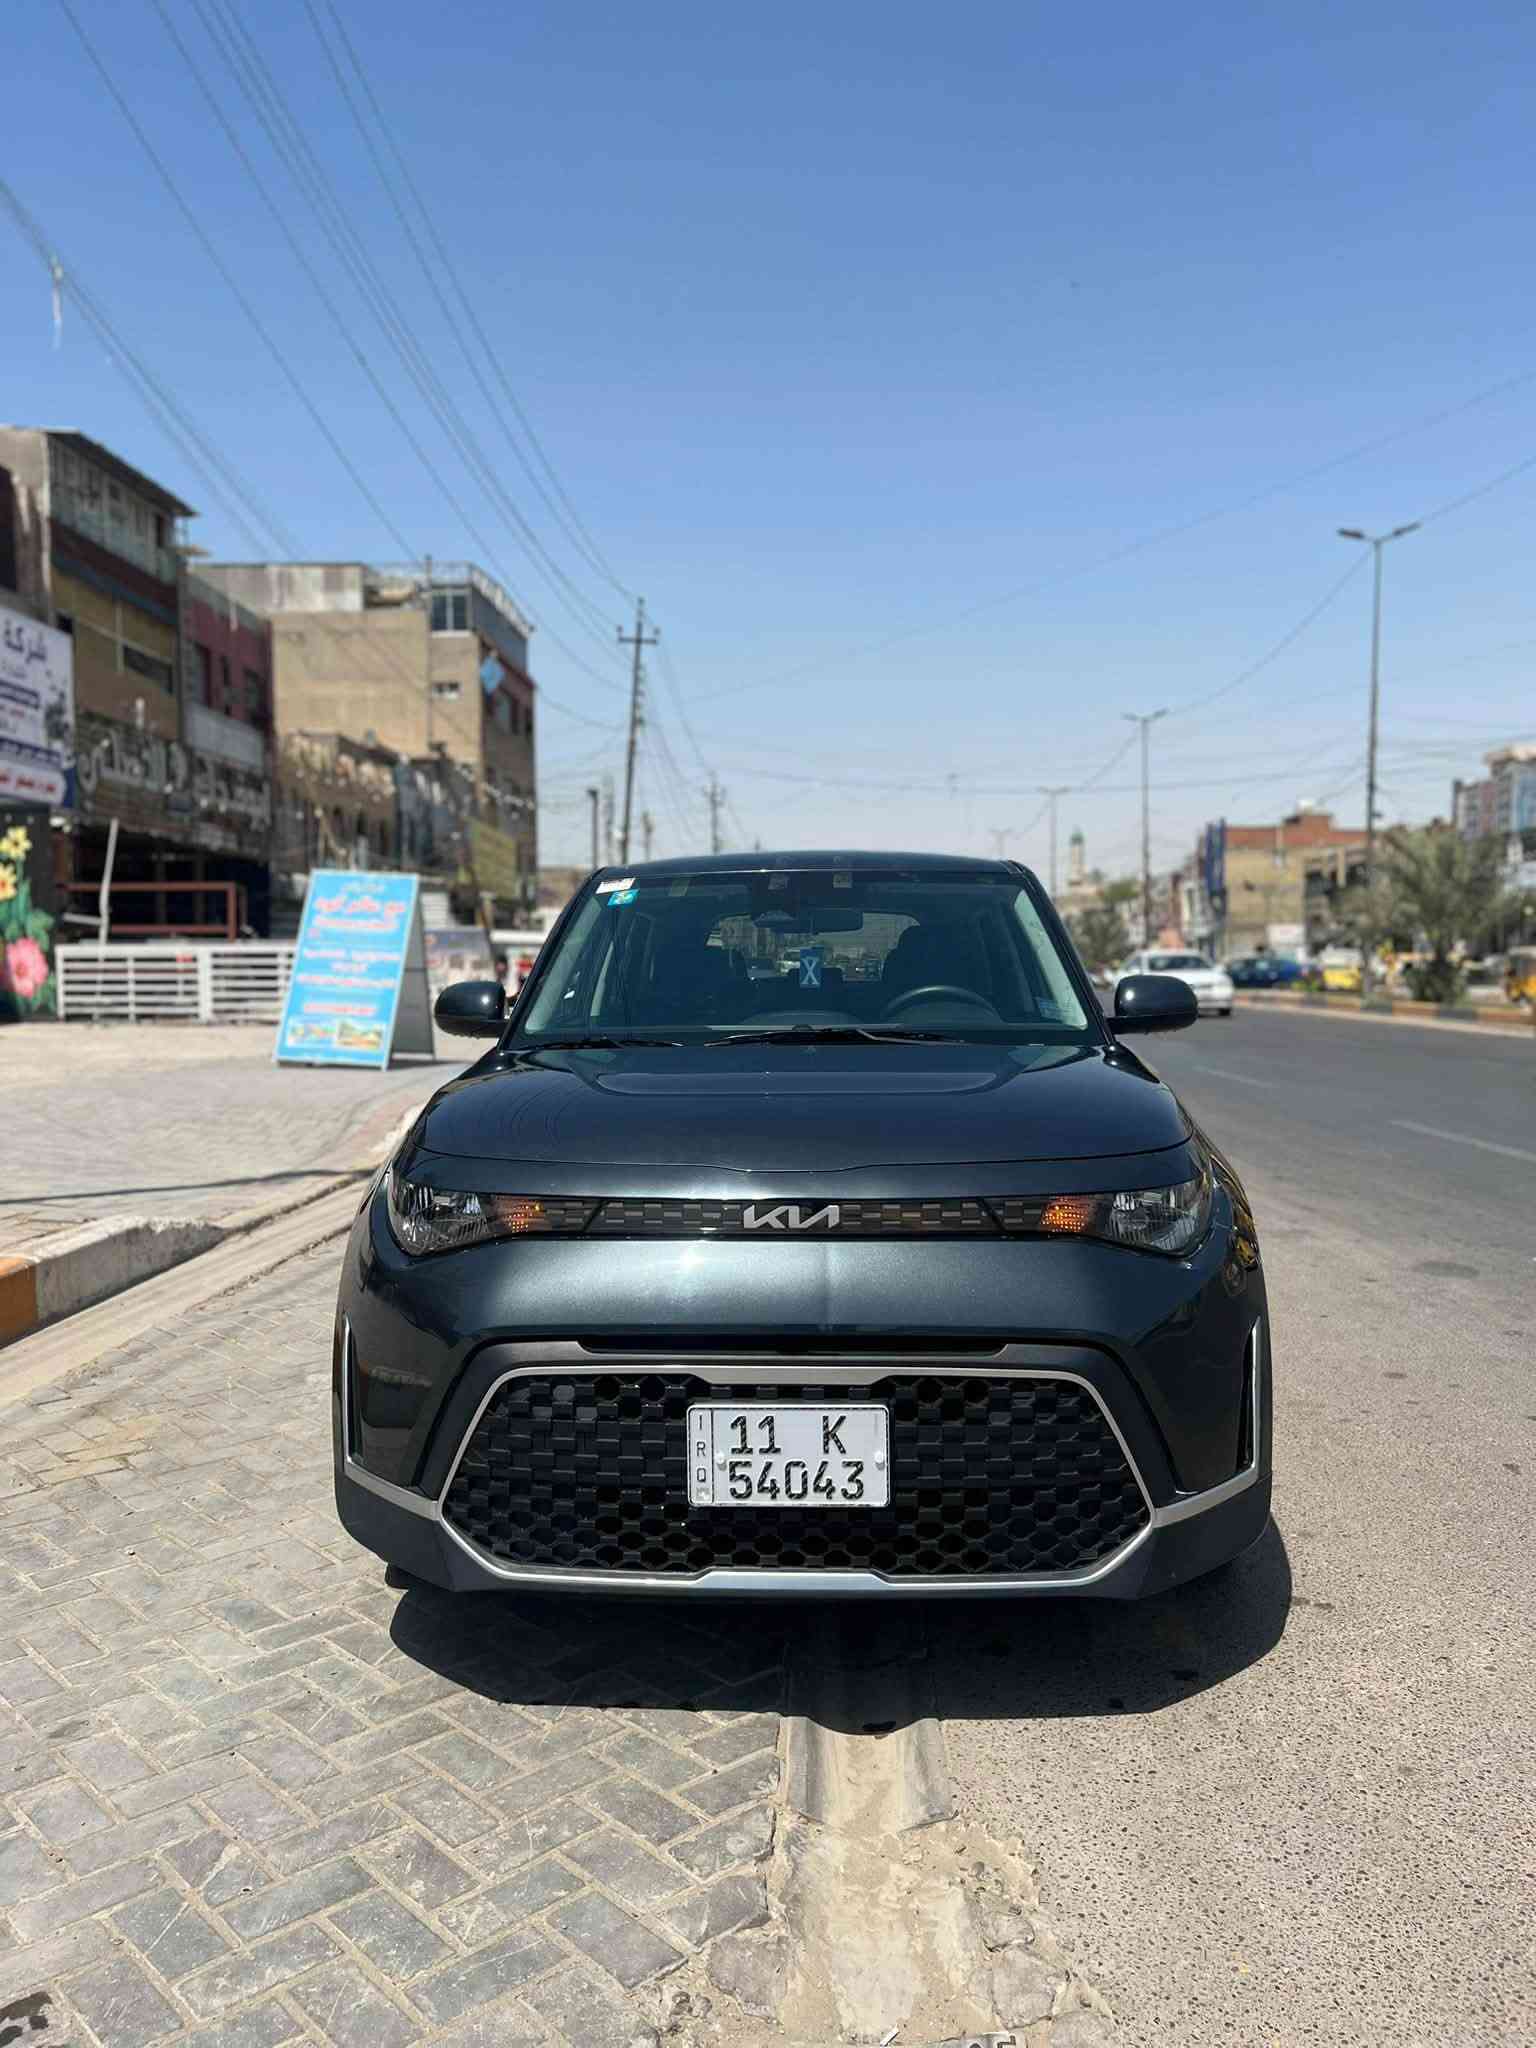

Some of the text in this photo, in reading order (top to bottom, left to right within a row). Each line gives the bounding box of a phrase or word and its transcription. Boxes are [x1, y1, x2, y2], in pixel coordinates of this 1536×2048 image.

[743, 1204, 840, 1229] KIA
[730, 1415, 847, 1455] 11 K
[728, 1460, 865, 1501] 54043
